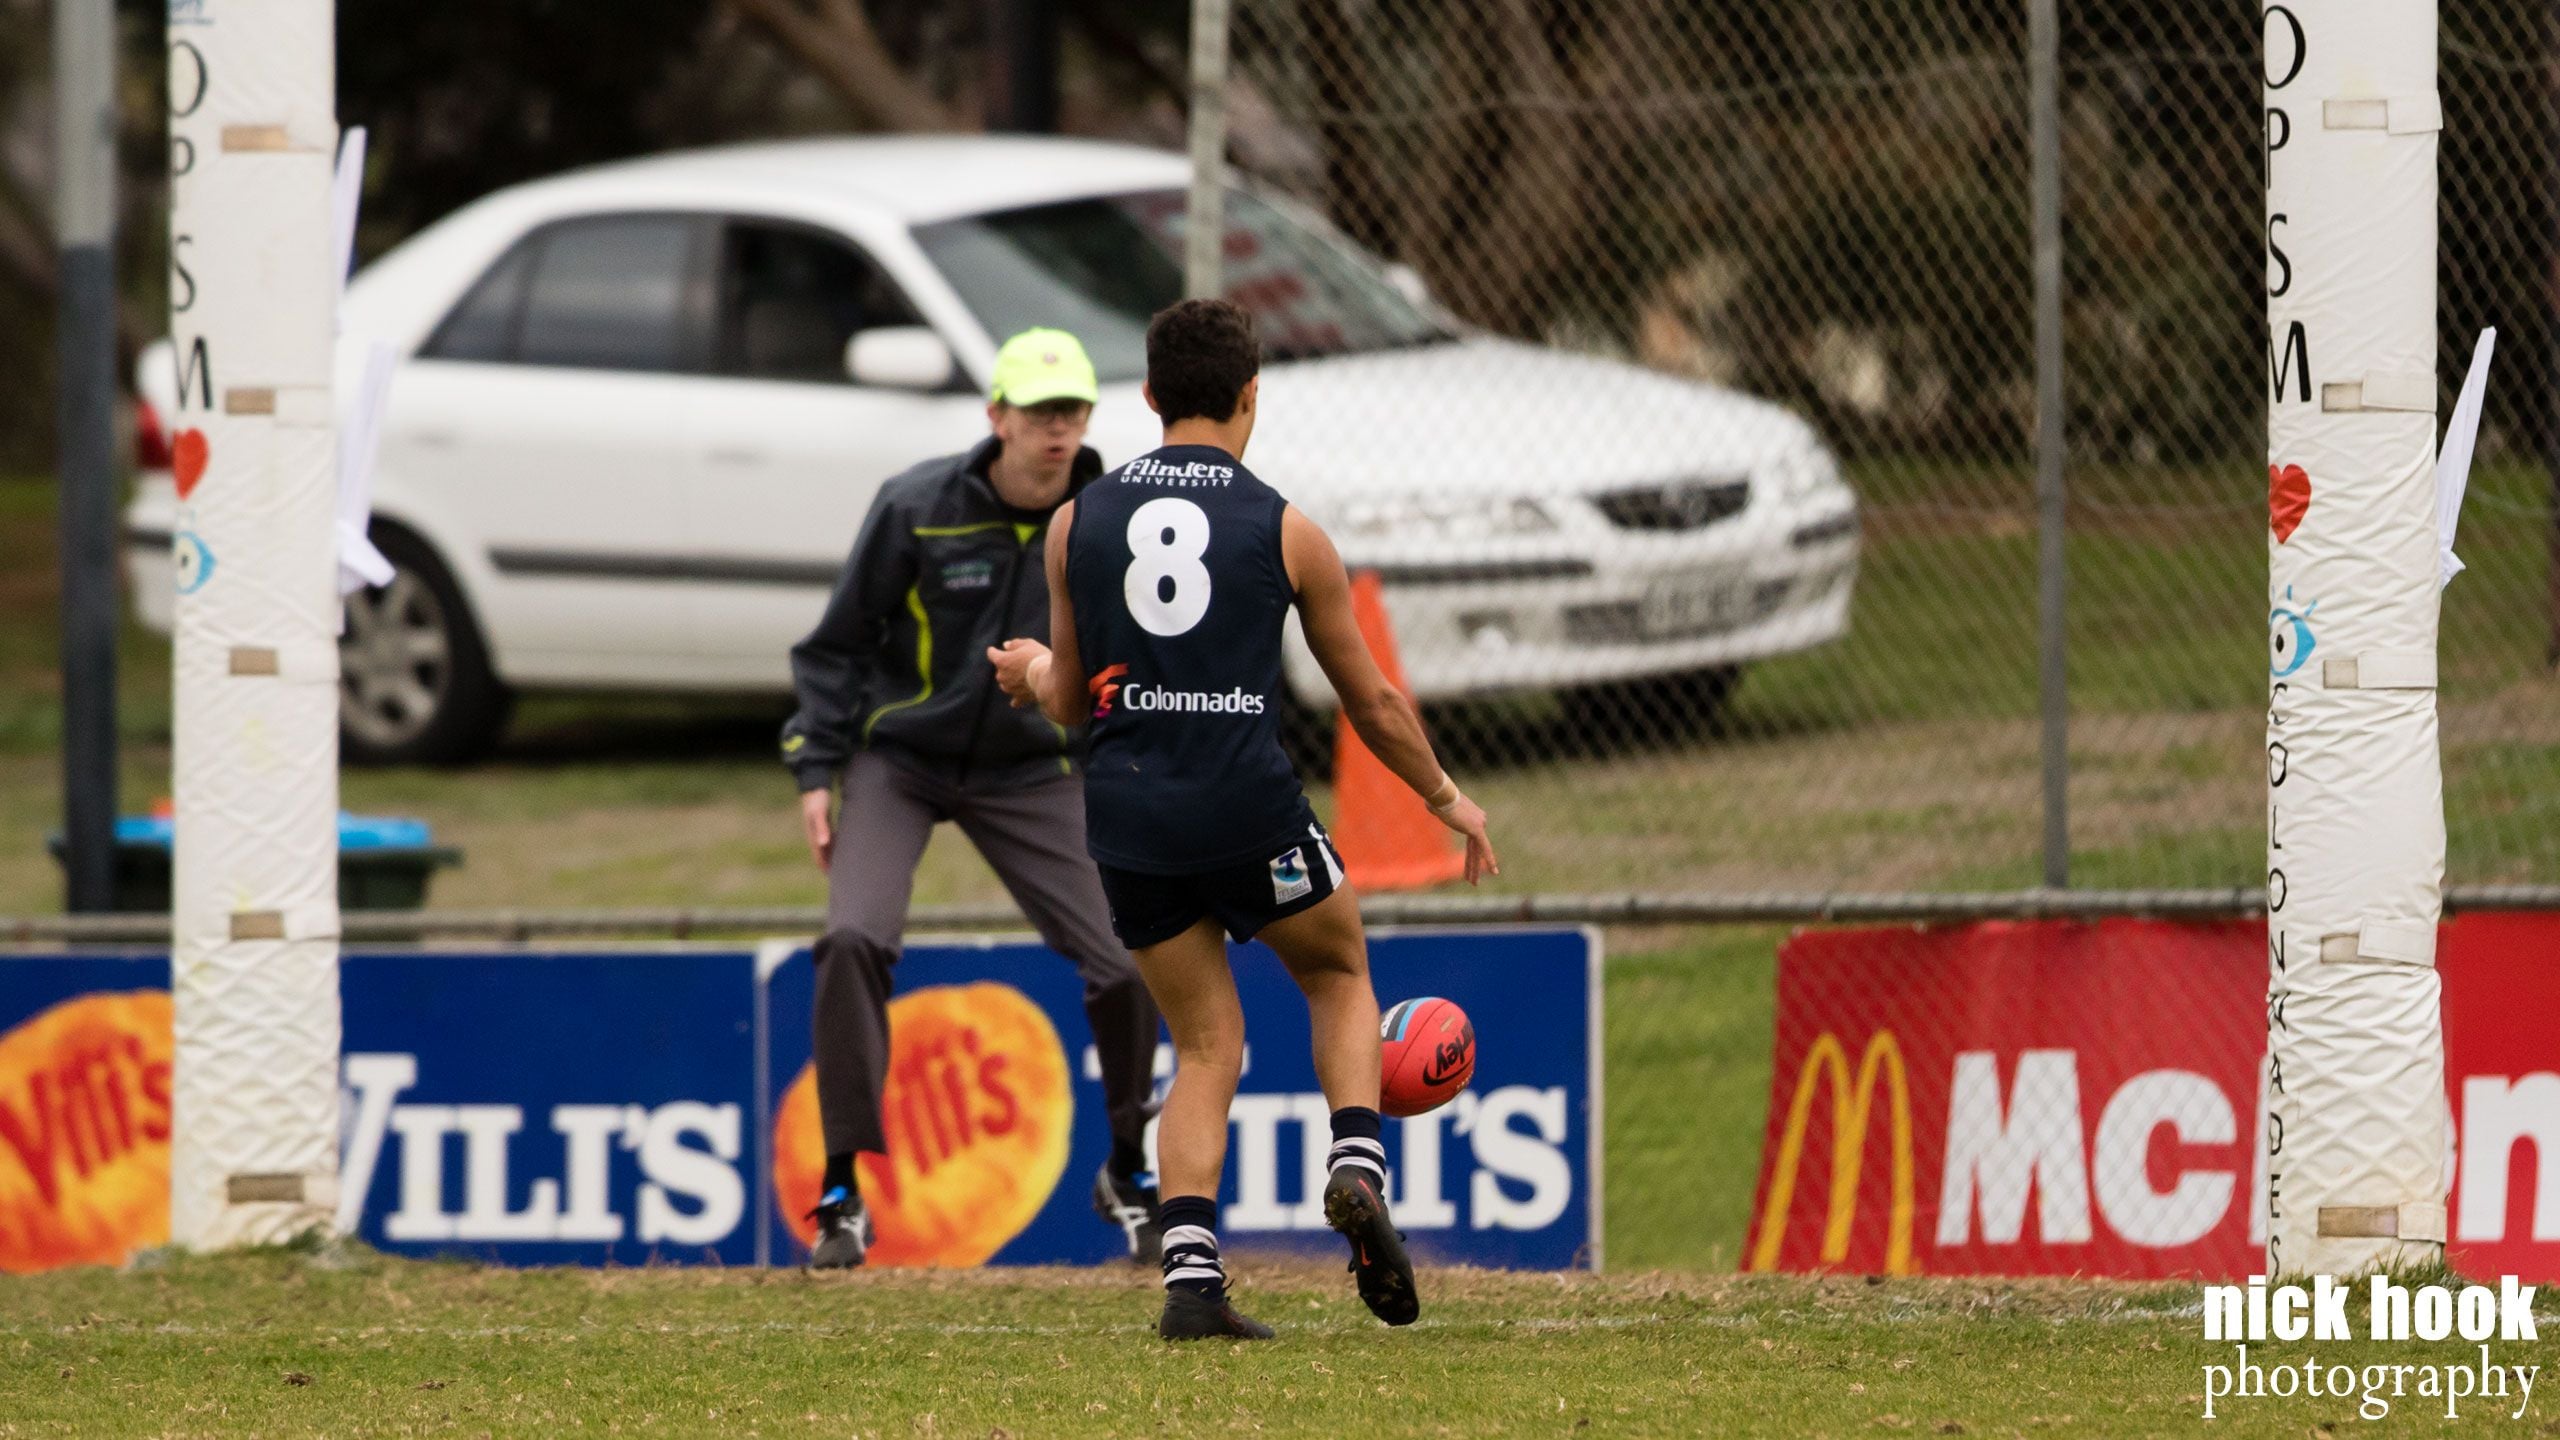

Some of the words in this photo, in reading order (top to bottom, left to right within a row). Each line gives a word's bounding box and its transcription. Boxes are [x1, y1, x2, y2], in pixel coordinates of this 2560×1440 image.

[1120, 475, 1232, 488] UNIVERSITY
[1122, 458, 1234, 479] Flinders
[1124, 497, 1212, 637] 8
[1123, 683, 1265, 715] Colonnades
